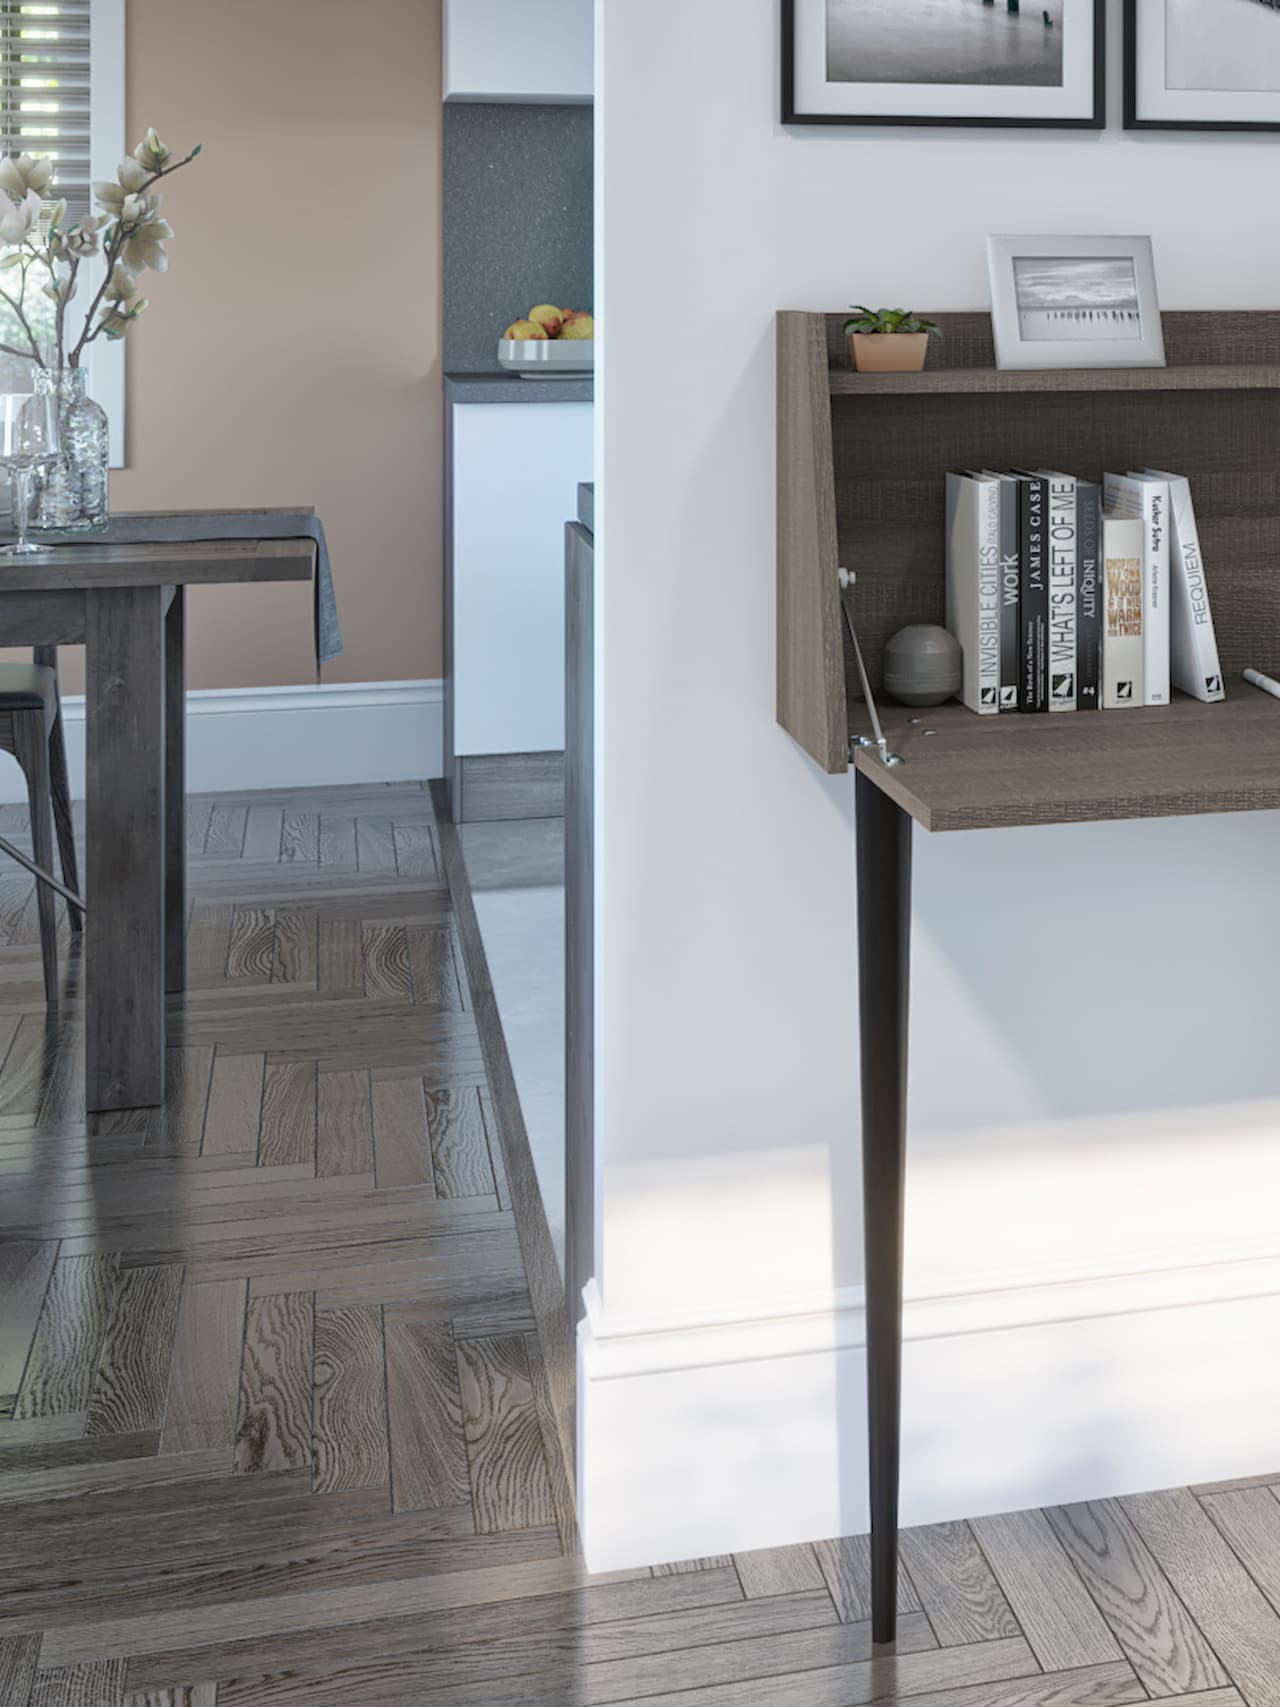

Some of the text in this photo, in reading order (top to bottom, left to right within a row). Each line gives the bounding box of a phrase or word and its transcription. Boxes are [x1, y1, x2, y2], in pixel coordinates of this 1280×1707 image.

[1030, 481, 1043, 590] JAMES CASE
[1051, 483, 1074, 662] WHAT'S LEFT OF ME
[980, 546, 998, 678] INVISIBLE CITIES
[1001, 554, 1019, 605] work
[1080, 559, 1095, 618] INIQUITY
[1107, 608, 1141, 629] WARM
[1183, 542, 1208, 625] REQUIEM
